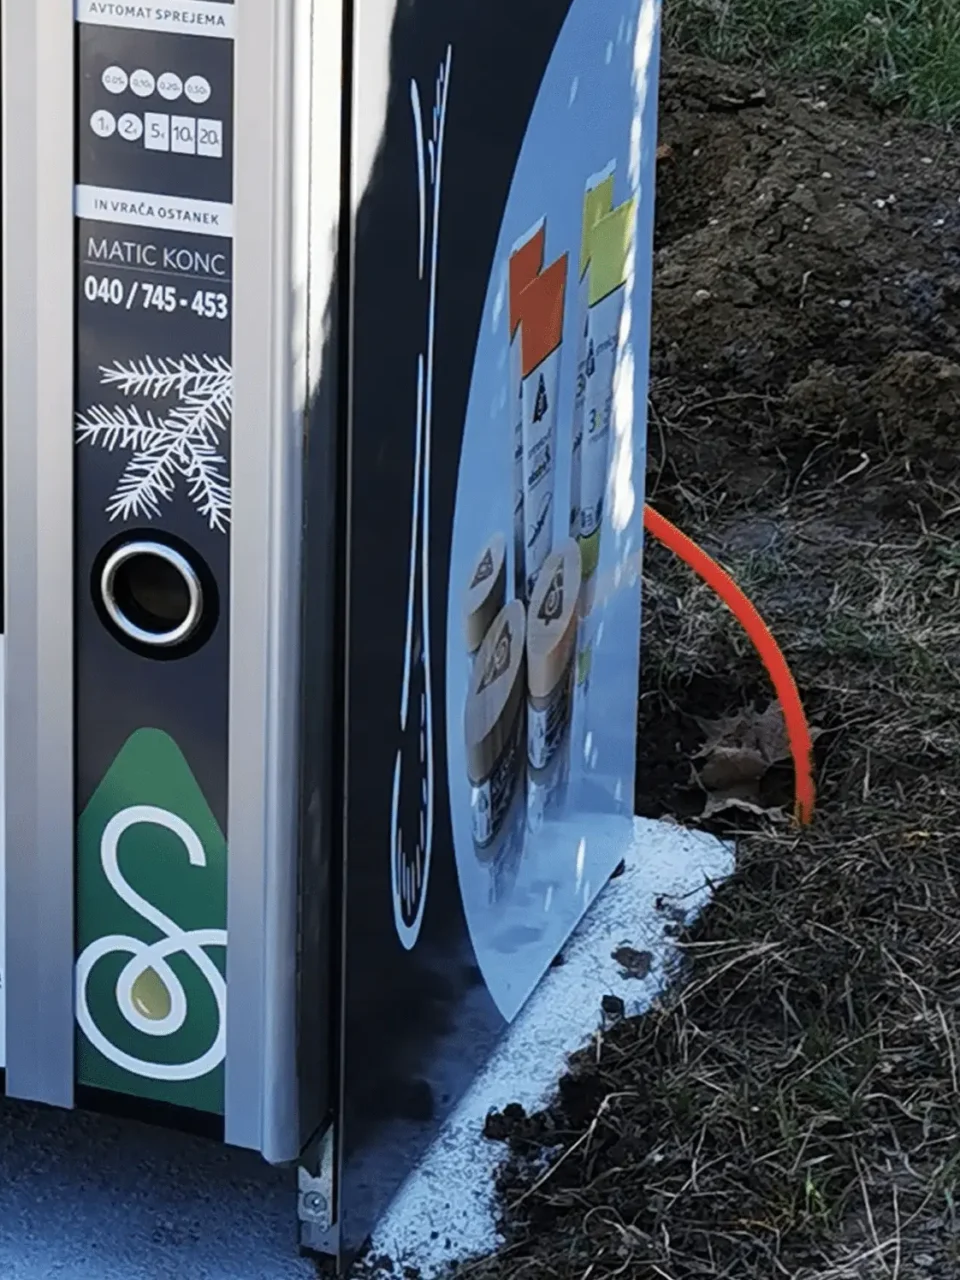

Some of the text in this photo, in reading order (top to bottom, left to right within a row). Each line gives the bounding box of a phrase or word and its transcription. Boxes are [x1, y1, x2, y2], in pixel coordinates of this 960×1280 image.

[89, 1, 226, 27] AVTOMAT SPREJEMA
[94, 198, 219, 226] IN VRAČA OSTANEK
[87, 236, 226, 276] MATIC KONC
[84, 275, 124, 305] 040
[125, 281, 138, 310] /
[141, 282, 177, 312] 745
[191, 289, 228, 320] 453
